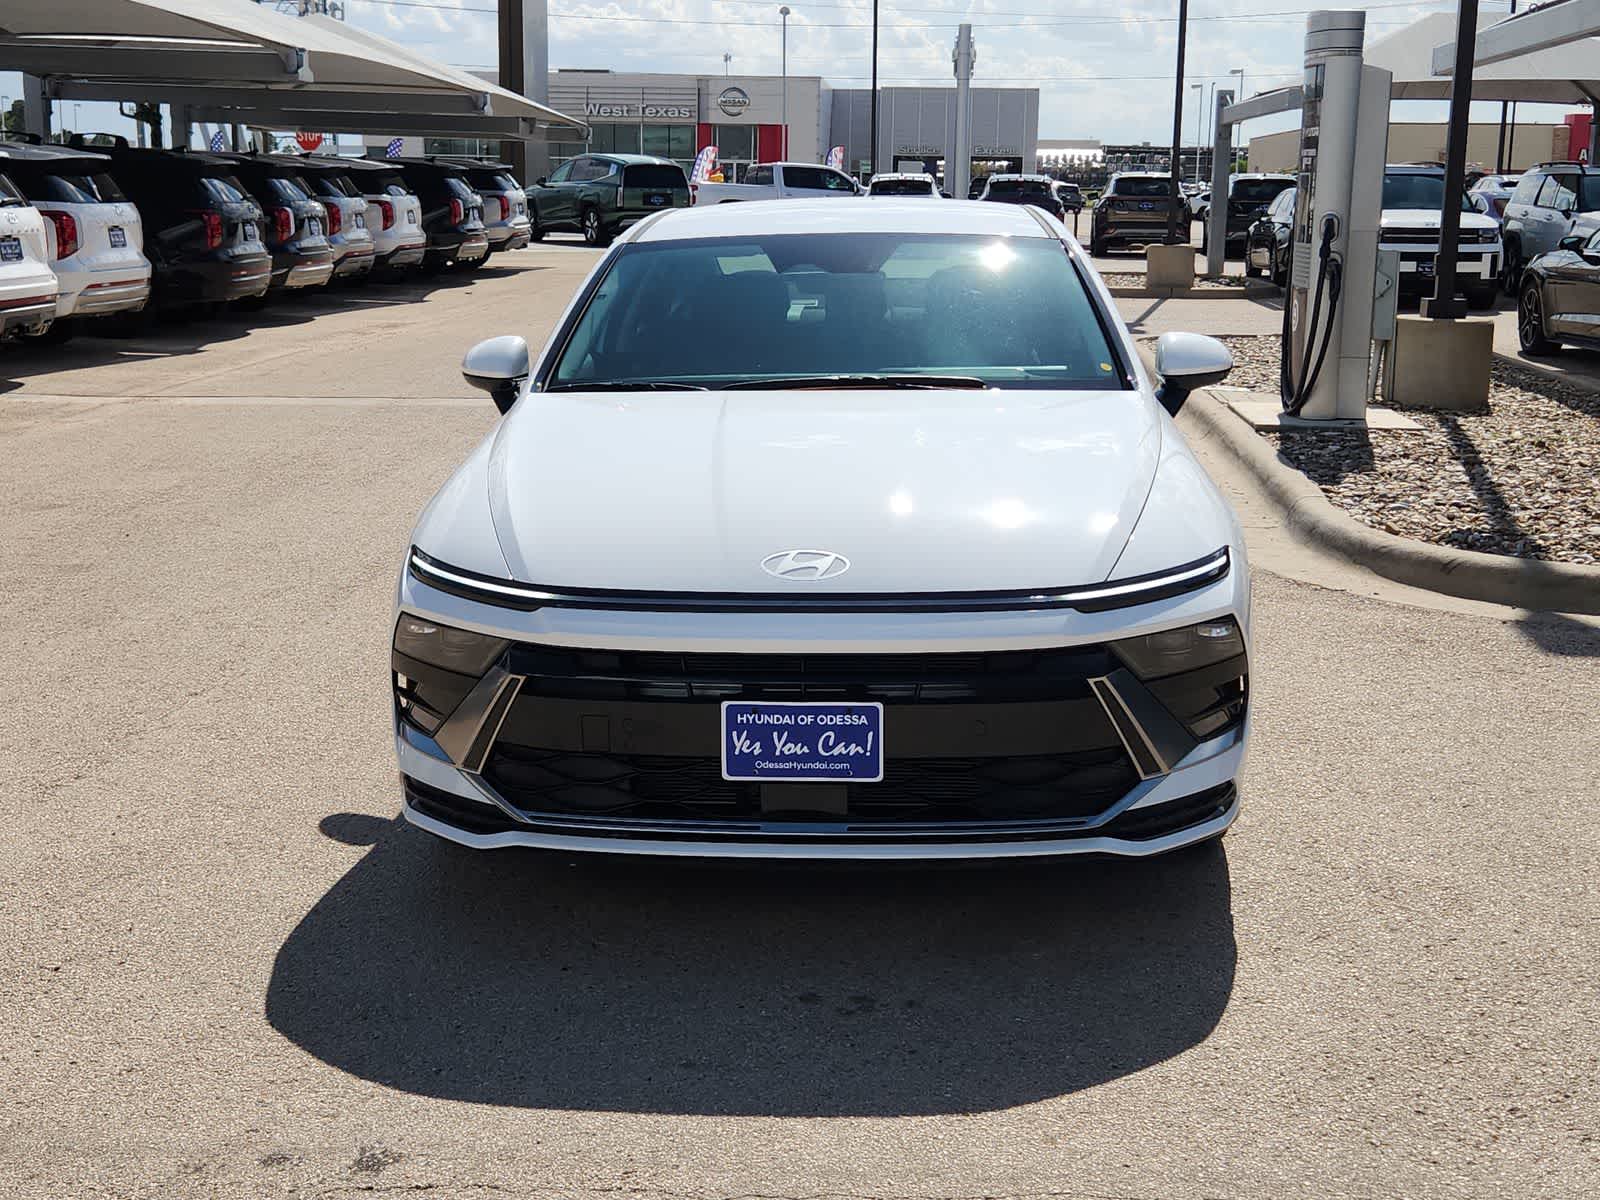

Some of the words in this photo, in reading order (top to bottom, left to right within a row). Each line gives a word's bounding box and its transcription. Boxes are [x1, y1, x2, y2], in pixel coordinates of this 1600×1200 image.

[720, 98, 748, 106] NISSAN
[584, 103, 629, 117] West
[636, 103, 692, 118] Texas
[297, 131, 320, 142] STOP
[737, 714, 794, 725] HYUNDAI
[797, 714, 815, 725] OF
[816, 714, 868, 725] ODESSA
[731, 730, 762, 756] Yes
[772, 730, 809, 756] You
[818, 730, 873, 756] Can!
[755, 760, 850, 771] OdessaHyundai.com
